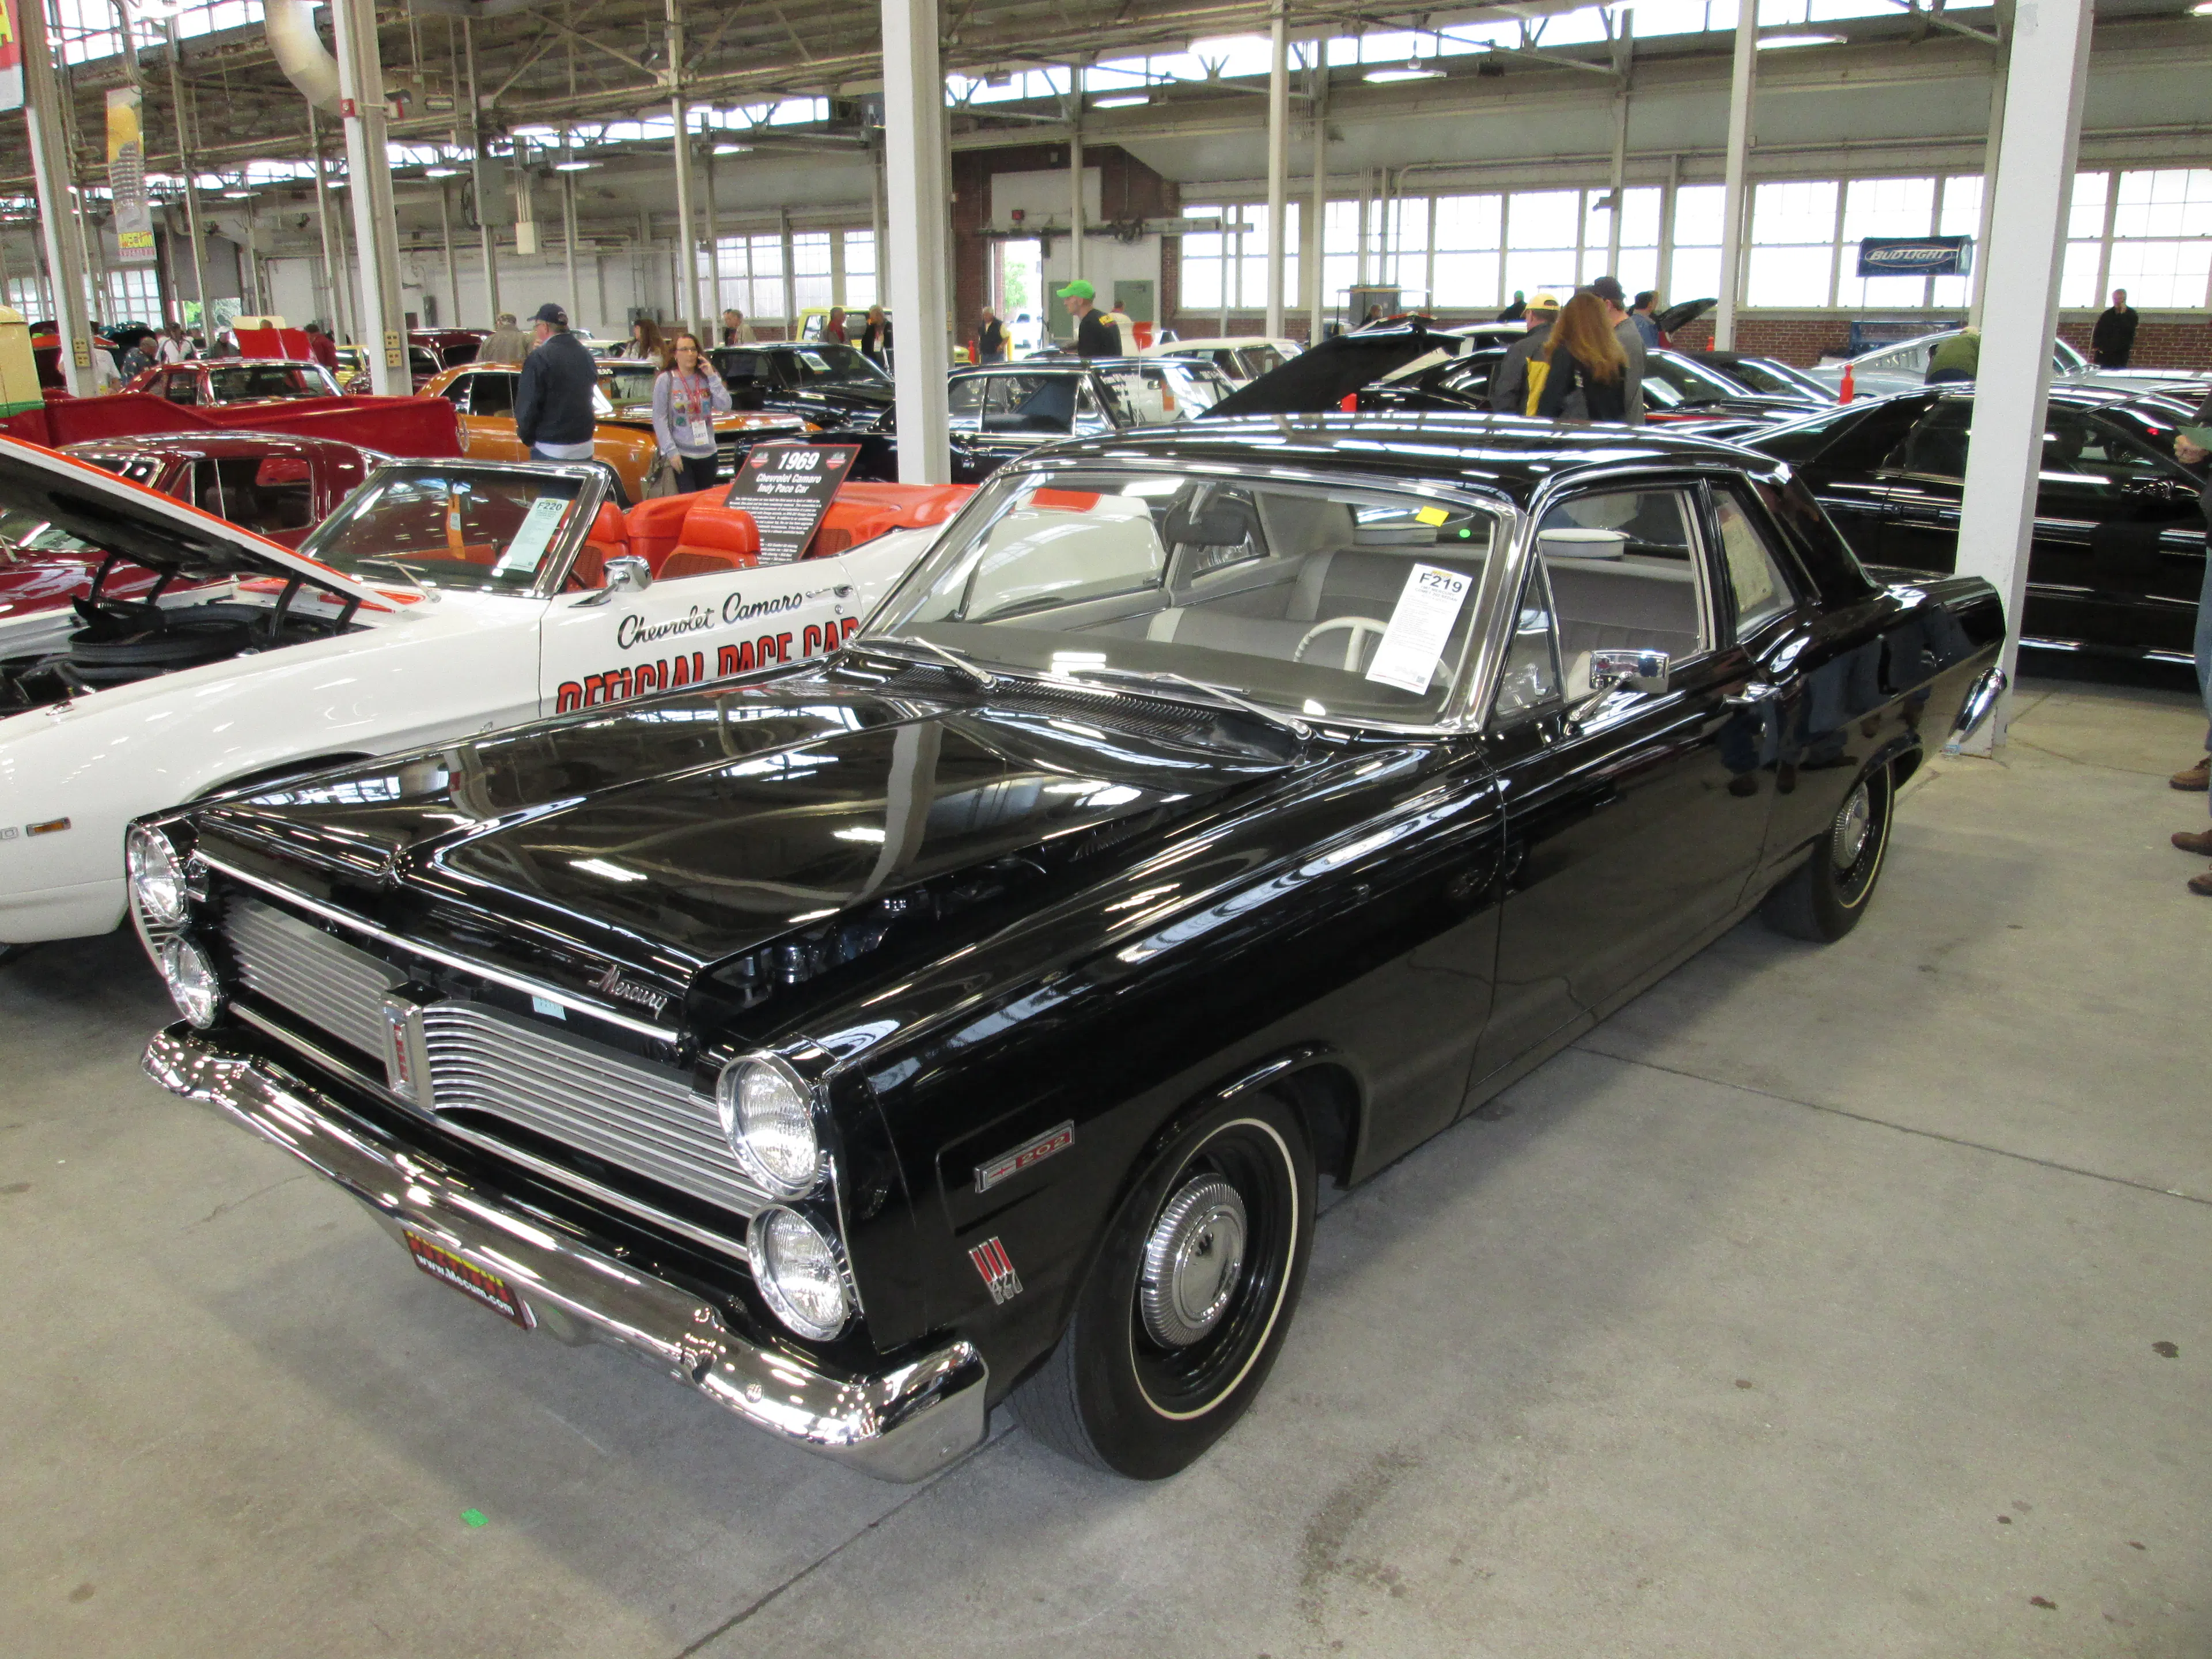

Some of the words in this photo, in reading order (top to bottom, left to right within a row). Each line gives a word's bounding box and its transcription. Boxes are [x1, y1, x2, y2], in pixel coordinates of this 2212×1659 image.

[1870, 250, 1904, 260] BUD
[1903, 249, 1946, 259] LIGHT
[778, 452, 820, 470] 1969
[756, 473, 793, 483] Chevrolet
[791, 474, 822, 483] Camaro
[757, 483, 775, 494] Indy
[775, 484, 794, 493] Pace
[795, 484, 809, 494] Car
[537, 502, 562, 511] F220
[1419, 573, 1463, 593] F219
[618, 604, 715, 650] Chevrolet
[722, 592, 803, 624] Camaro
[586, 964, 668, 1020] Mercury
[1021, 1135, 1066, 1165] 202
